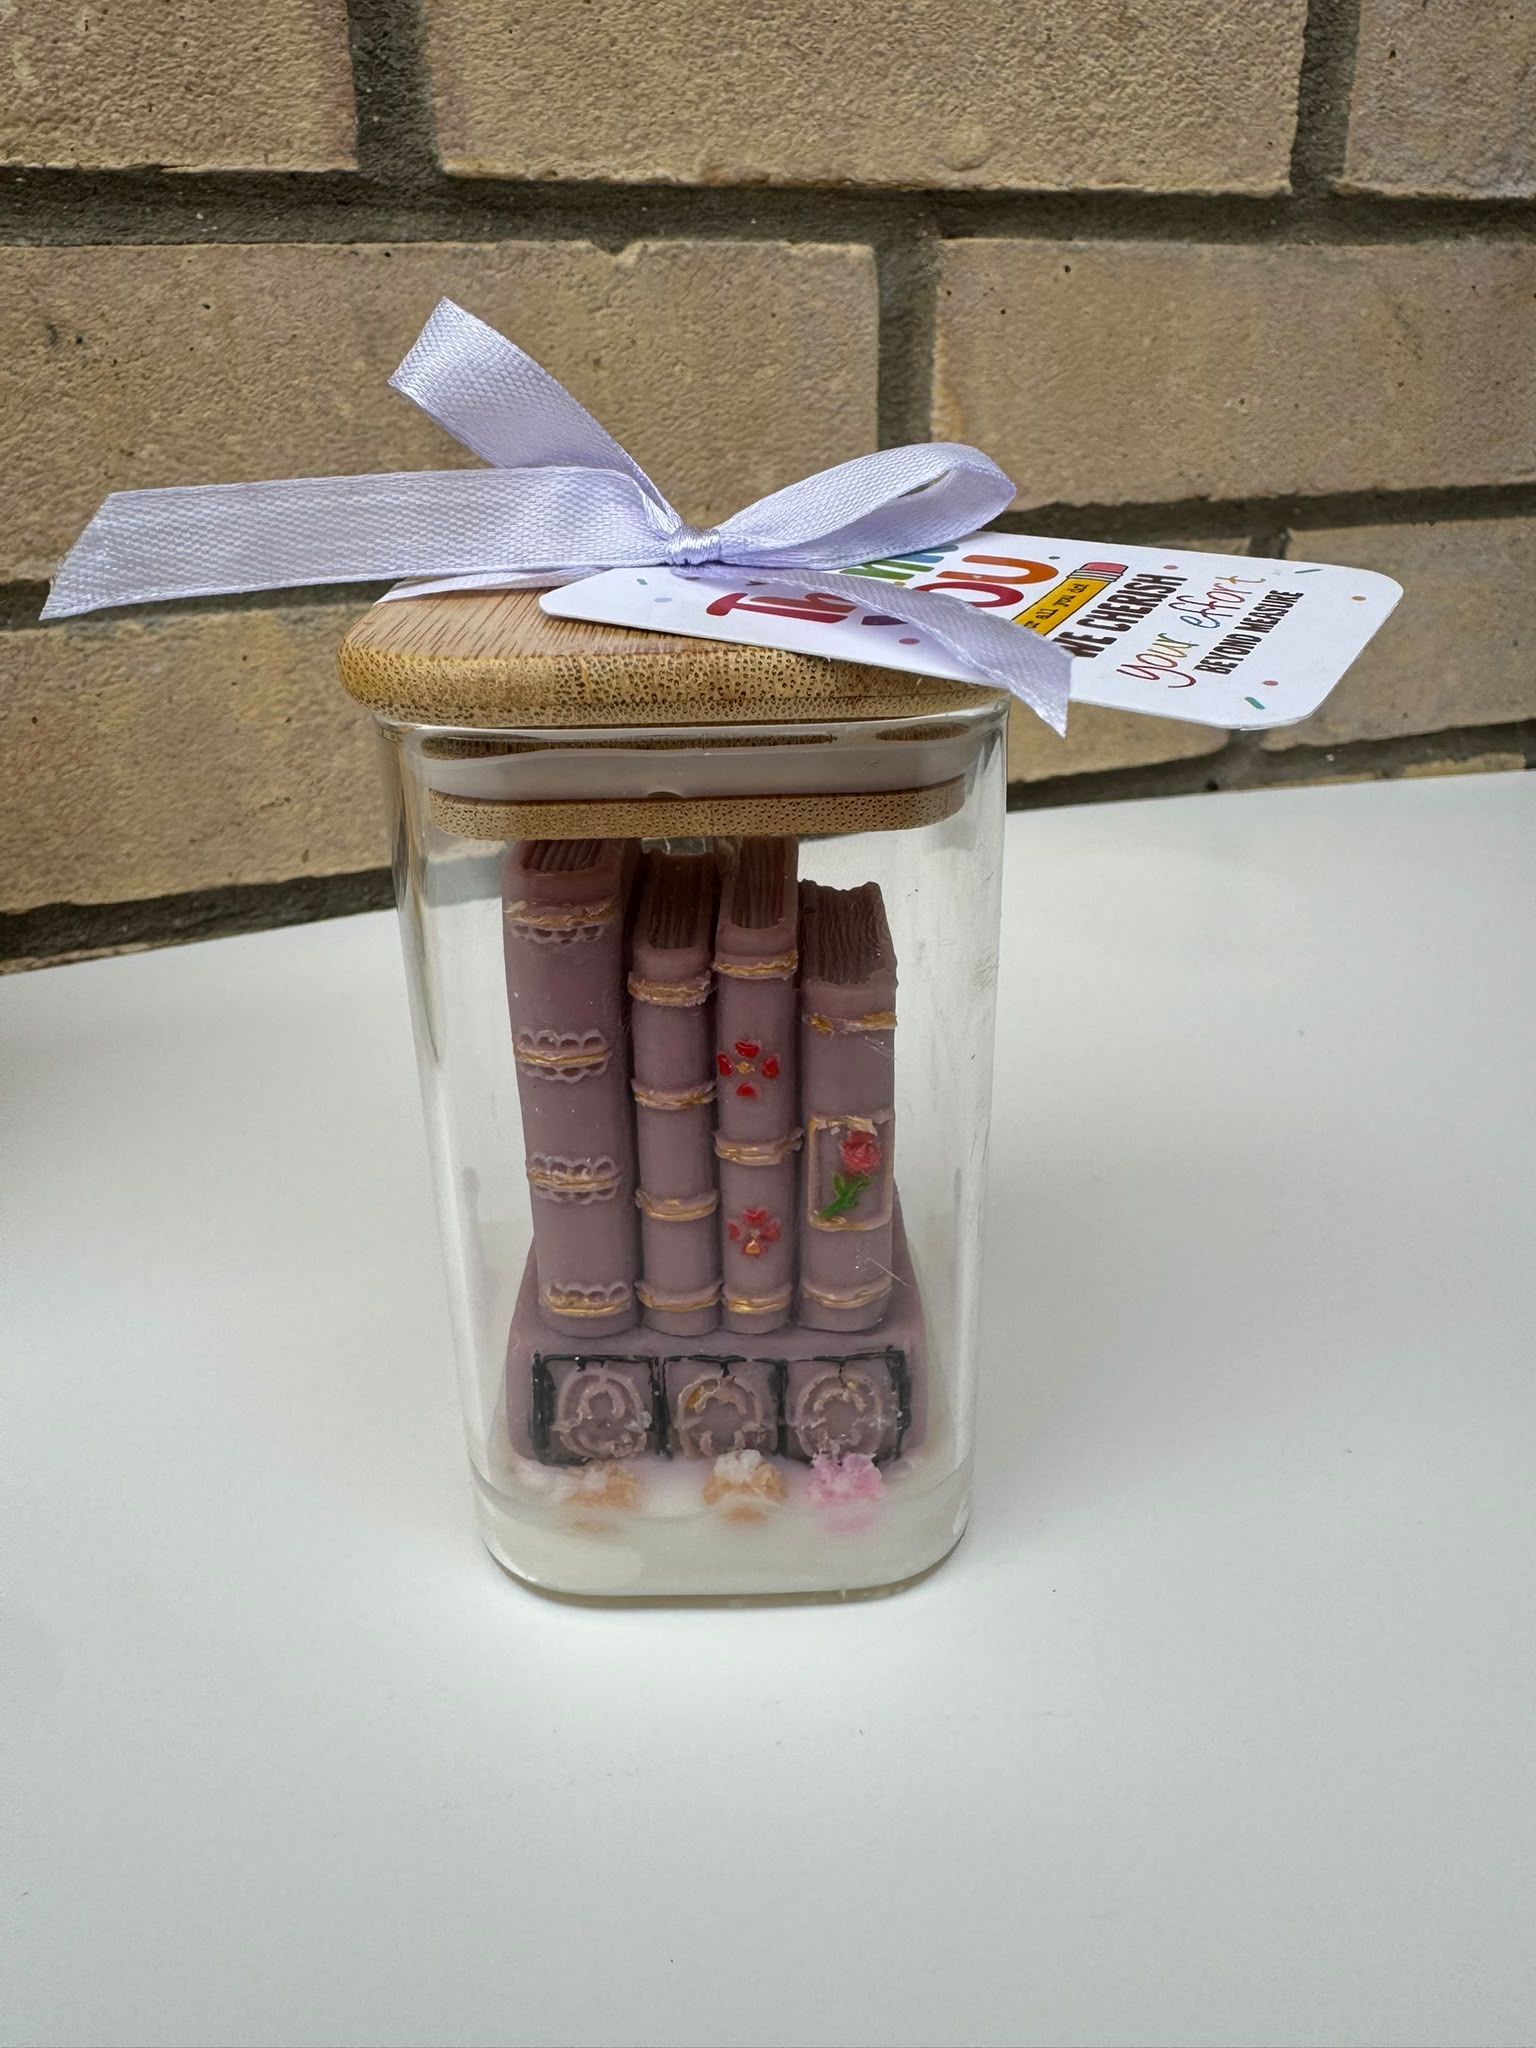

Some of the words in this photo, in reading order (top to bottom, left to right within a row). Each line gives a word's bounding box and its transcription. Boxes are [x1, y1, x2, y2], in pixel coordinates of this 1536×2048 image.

[861, 555, 1059, 626] OU
[1035, 608, 1059, 619] all
[1076, 573, 1188, 632] CHERISH
[1052, 631, 1118, 658] WE
[1116, 632, 1200, 688] your
[1168, 575, 1266, 629] effort
[1192, 633, 1263, 675] BEYOND
[1234, 590, 1304, 634] MEASURE
